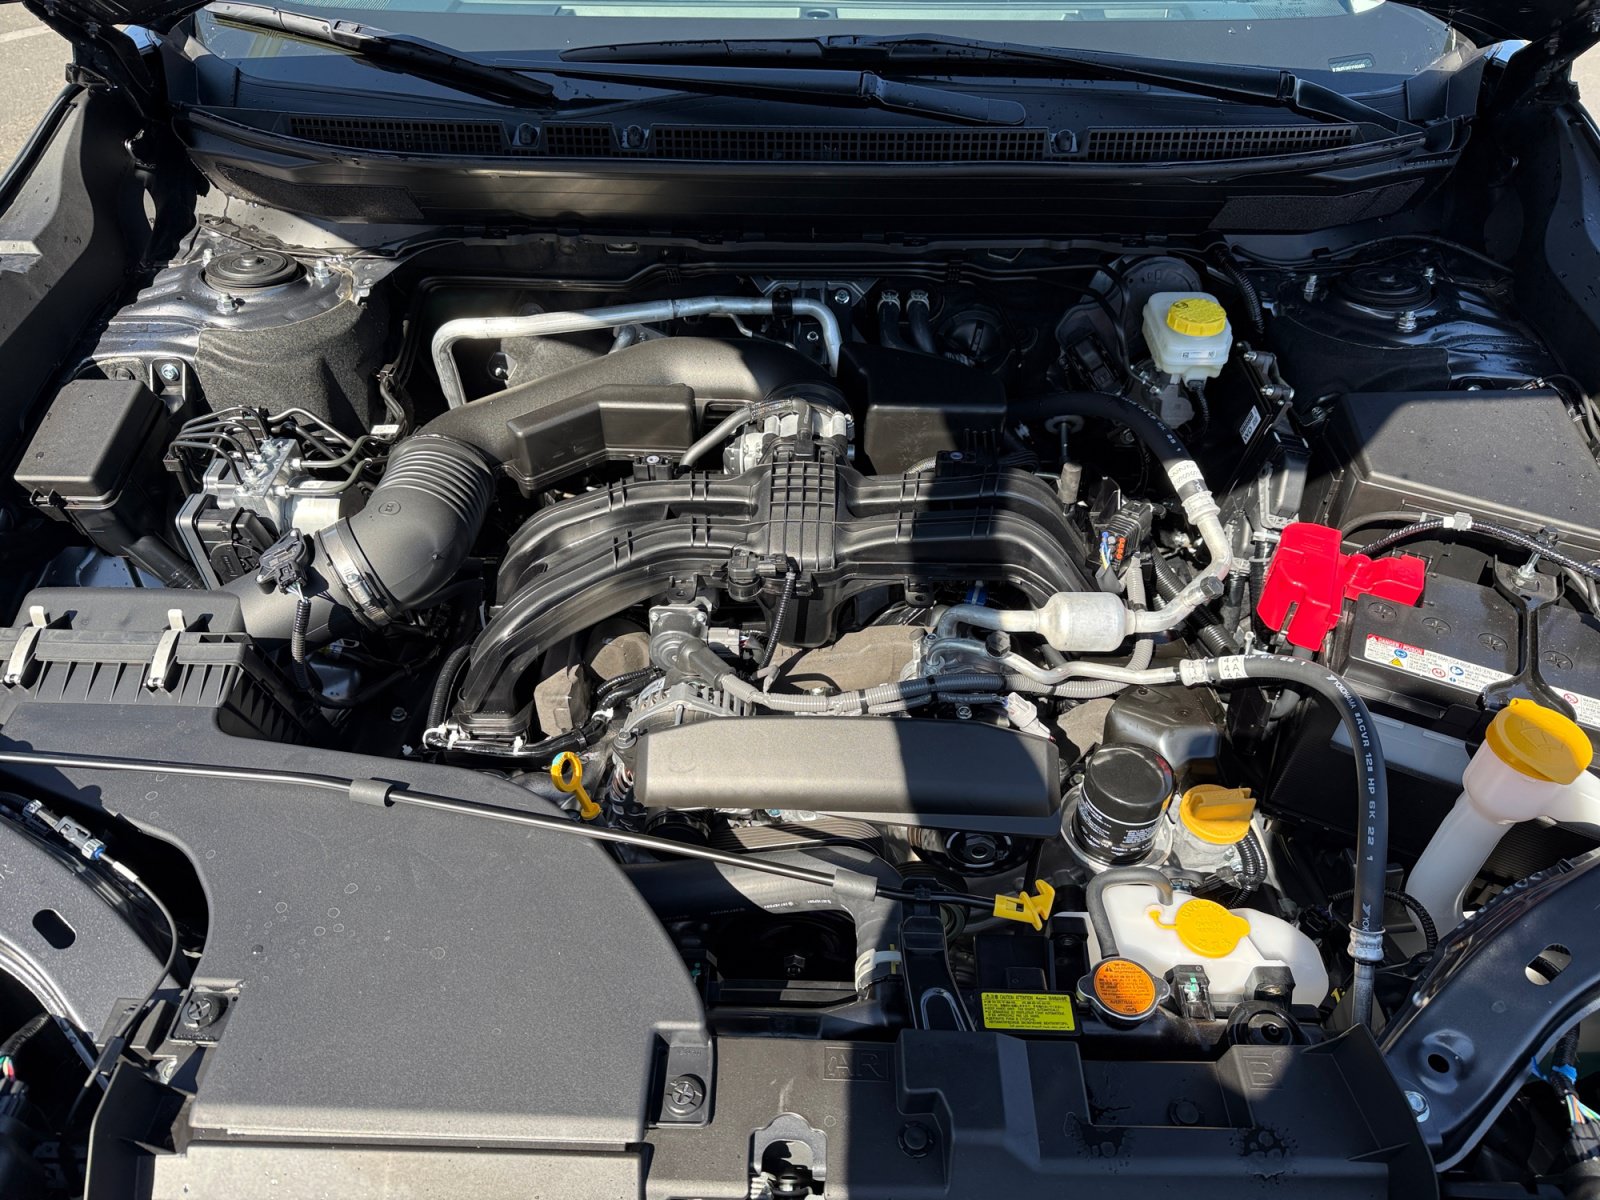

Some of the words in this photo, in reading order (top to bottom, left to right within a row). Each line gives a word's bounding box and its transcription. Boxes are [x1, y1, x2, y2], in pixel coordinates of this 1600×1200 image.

[1334, 679, 1358, 710] YOKOHAMA
[1367, 777, 1376, 795] HP
[1367, 825, 1375, 846] 22
